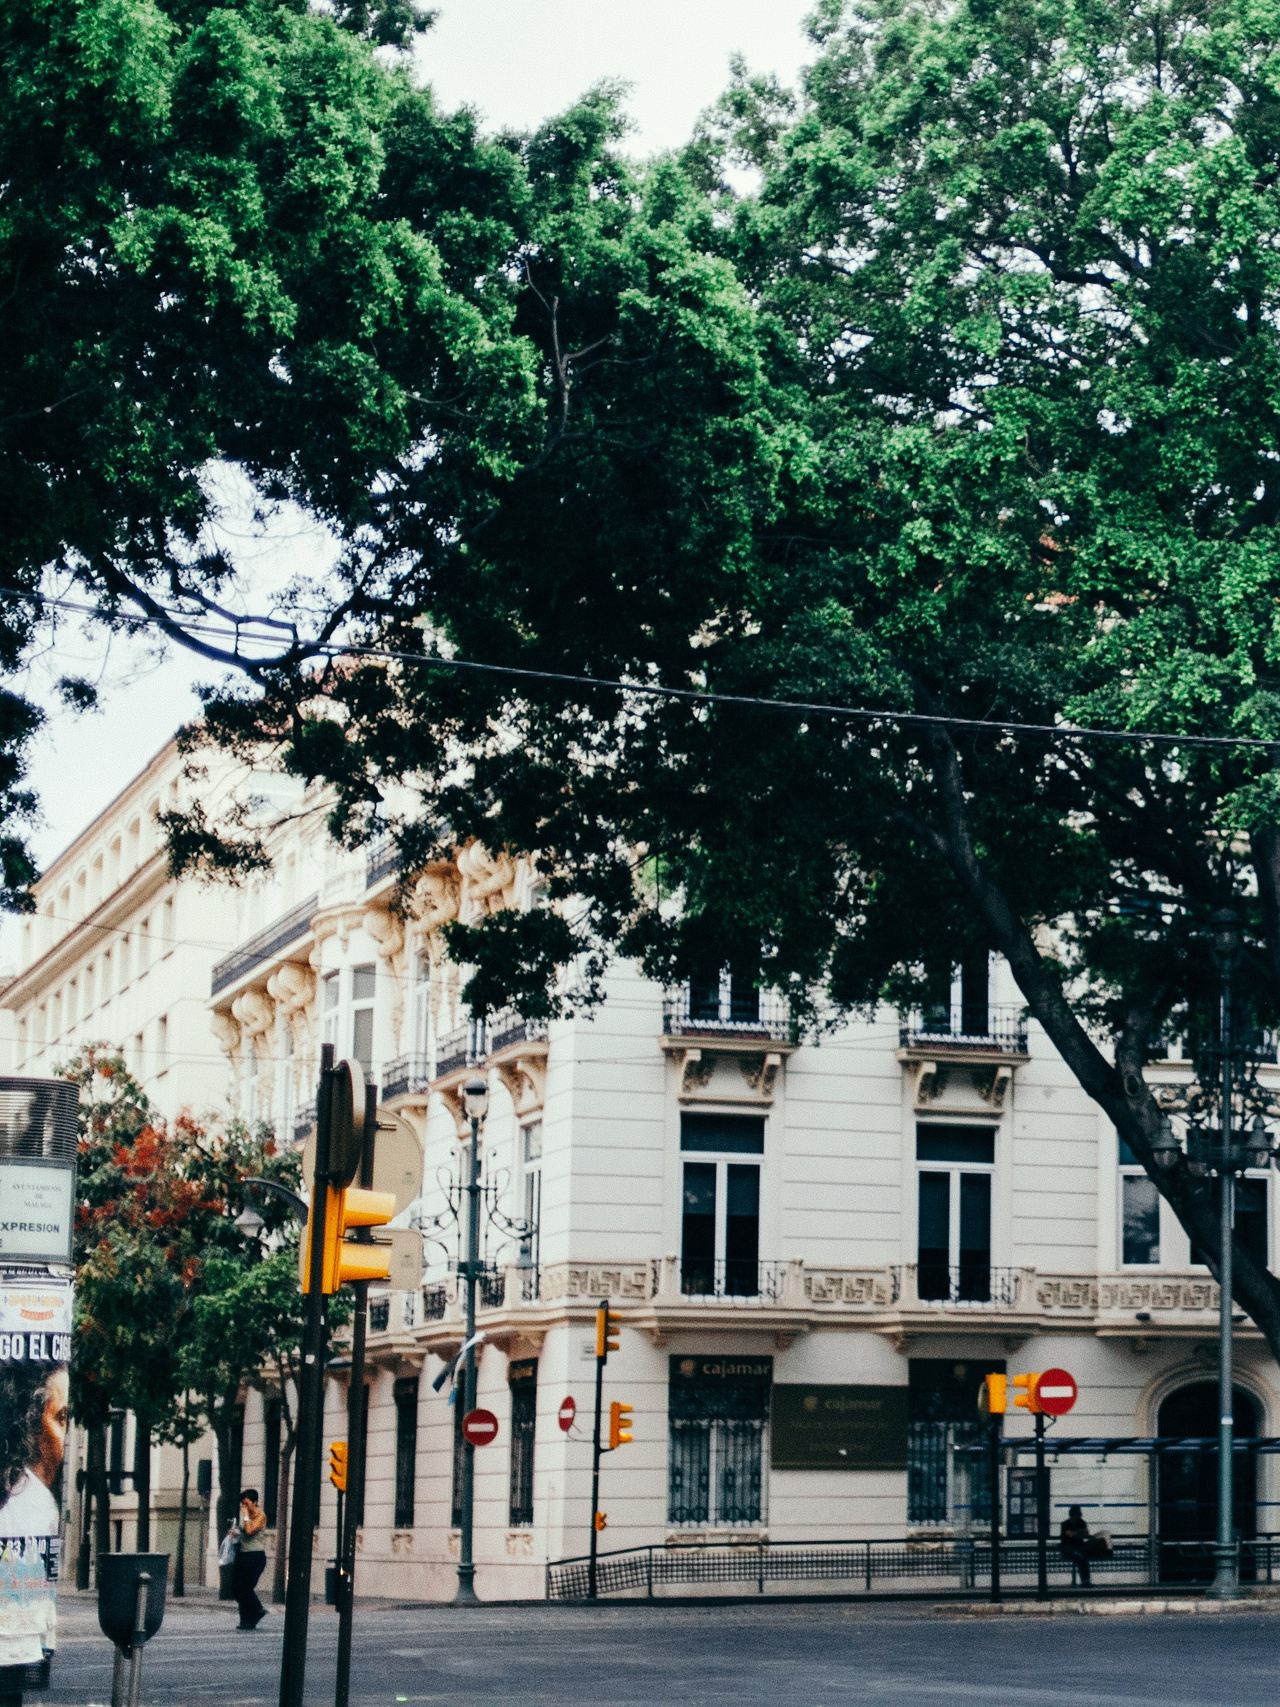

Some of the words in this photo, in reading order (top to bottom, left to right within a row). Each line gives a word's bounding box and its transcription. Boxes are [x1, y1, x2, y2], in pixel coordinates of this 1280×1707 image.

[29, 1333, 50, 1360] EL
[702, 1360, 770, 1379] cajamar
[824, 1396, 883, 1412] cajamar
